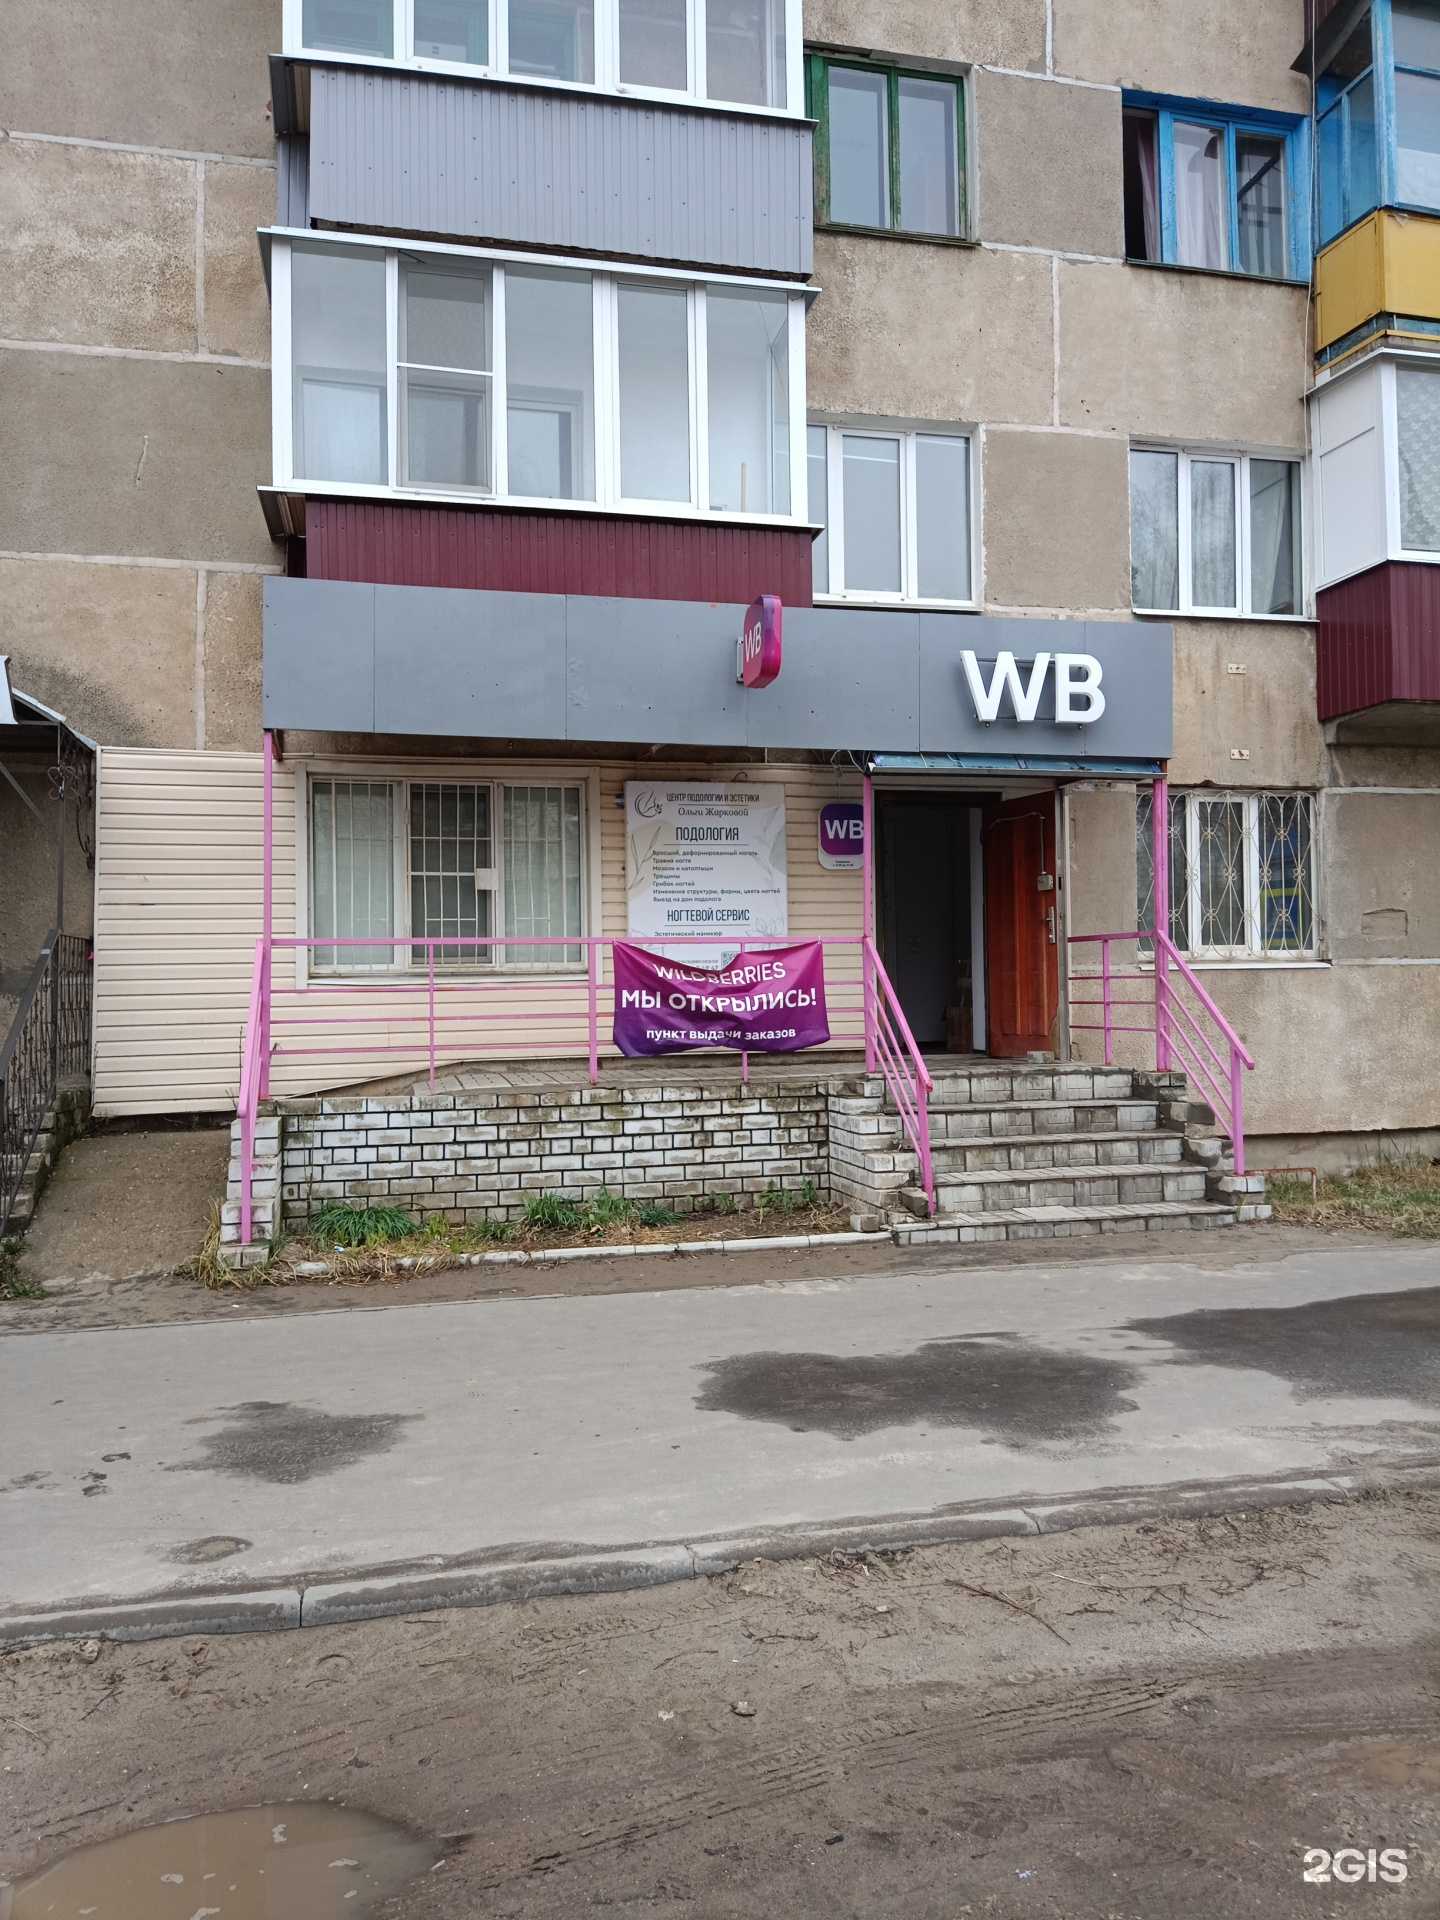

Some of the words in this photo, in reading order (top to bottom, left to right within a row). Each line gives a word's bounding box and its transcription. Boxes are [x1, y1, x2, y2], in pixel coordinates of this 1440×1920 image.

[744, 621, 762, 662] WB
[960, 649, 1106, 724] WB
[666, 793, 686, 802] ЦЕНТР
[687, 793, 723, 802] ПОДОЛОГИИ
[729, 794, 760, 803] ЭСТЕТИКИ
[678, 807, 703, 816] Ольги
[676, 826, 739, 842] ПОДОЛОГИЯ
[824, 819, 864, 840] WB
[667, 908, 713, 922] НОГТЕВОЙ
[715, 909, 750, 921] СЕРВИС
[653, 961, 786, 985] WILDBERRIES
[622, 989, 661, 1009] МЫ
[668, 987, 817, 1013] ОТКРЫЛИСЬ!
[646, 1029, 686, 1041] пункт
[689, 1028, 741, 1041] выдачи
[744, 1027, 796, 1041] заказов
